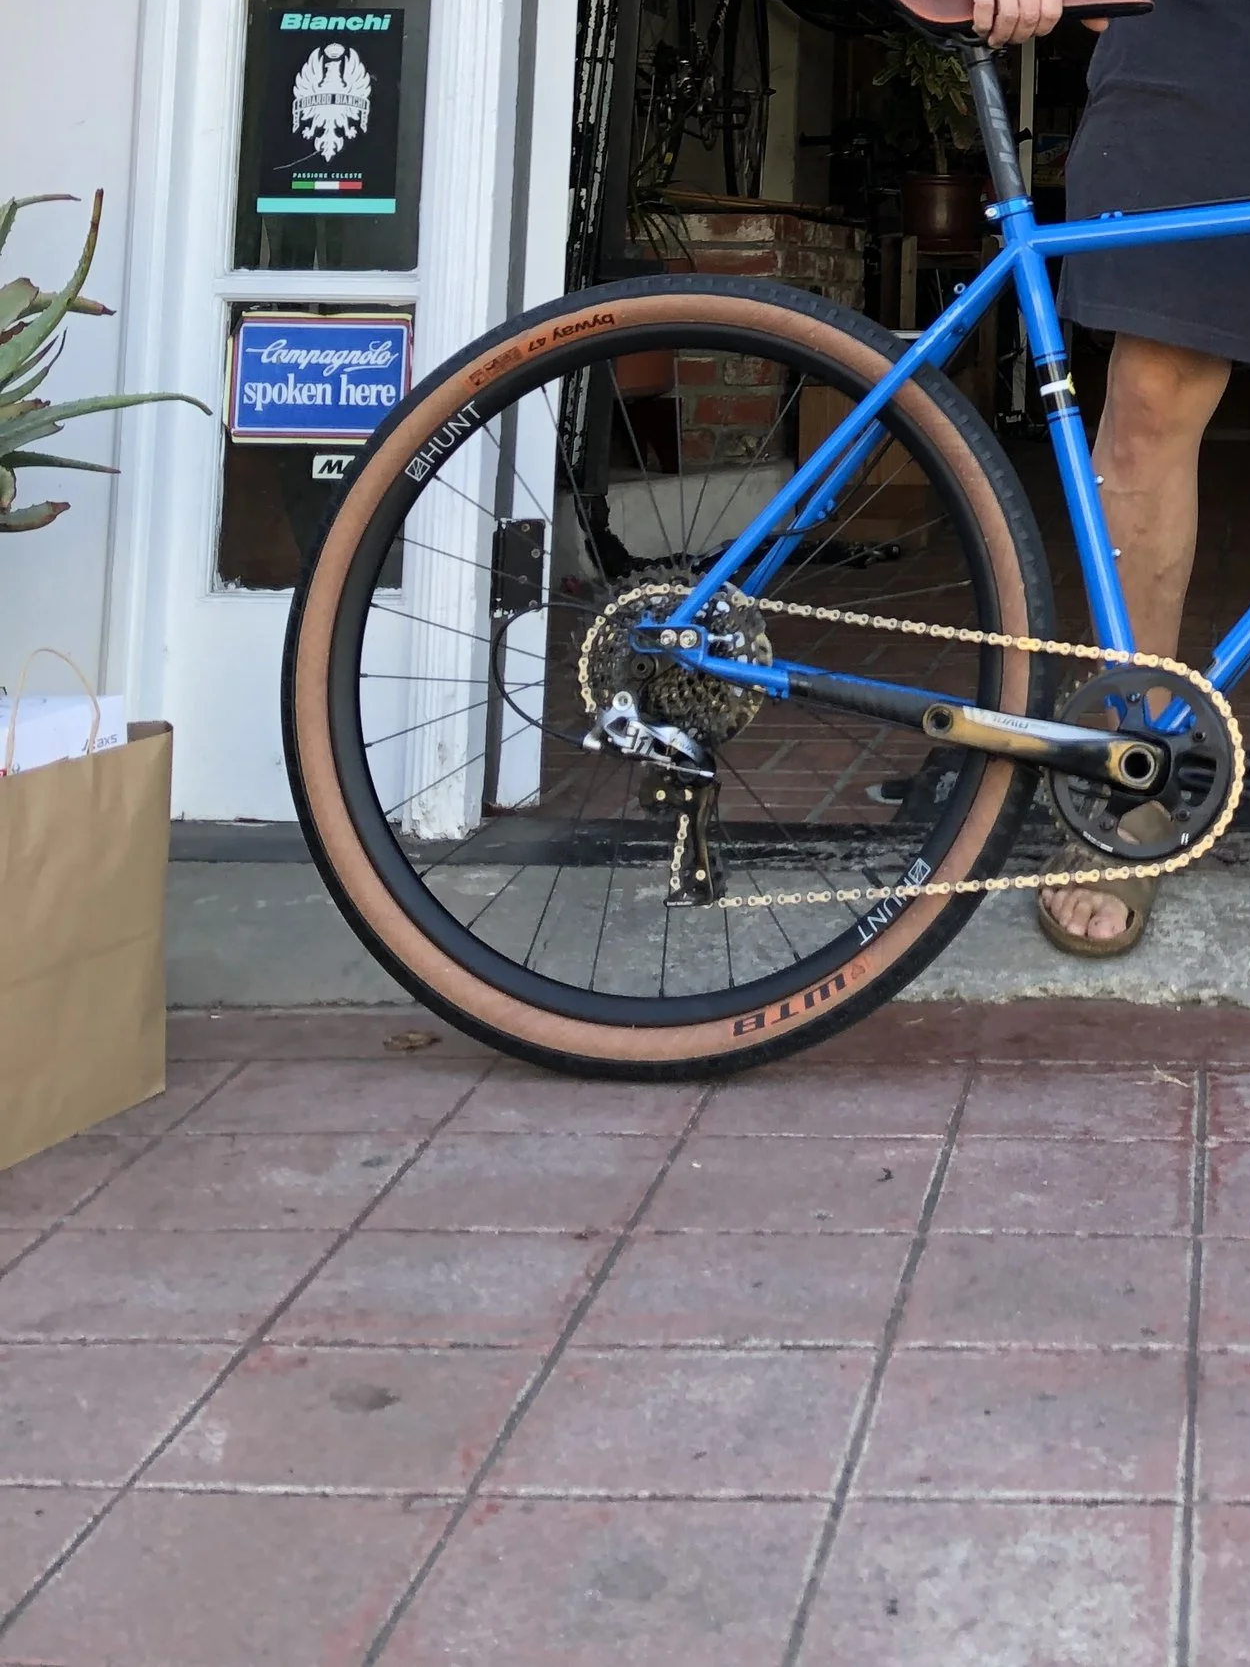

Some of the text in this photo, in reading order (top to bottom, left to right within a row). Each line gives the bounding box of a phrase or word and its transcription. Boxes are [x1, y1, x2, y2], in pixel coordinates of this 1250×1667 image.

[280, 13, 392, 31] Bianchi
[335, 94, 366, 110] BIANCHI
[527, 312, 616, 352] byway 47
[245, 338, 399, 377] Campagnolo
[243, 373, 396, 411] spoken here
[419, 400, 482, 464] HUNT
